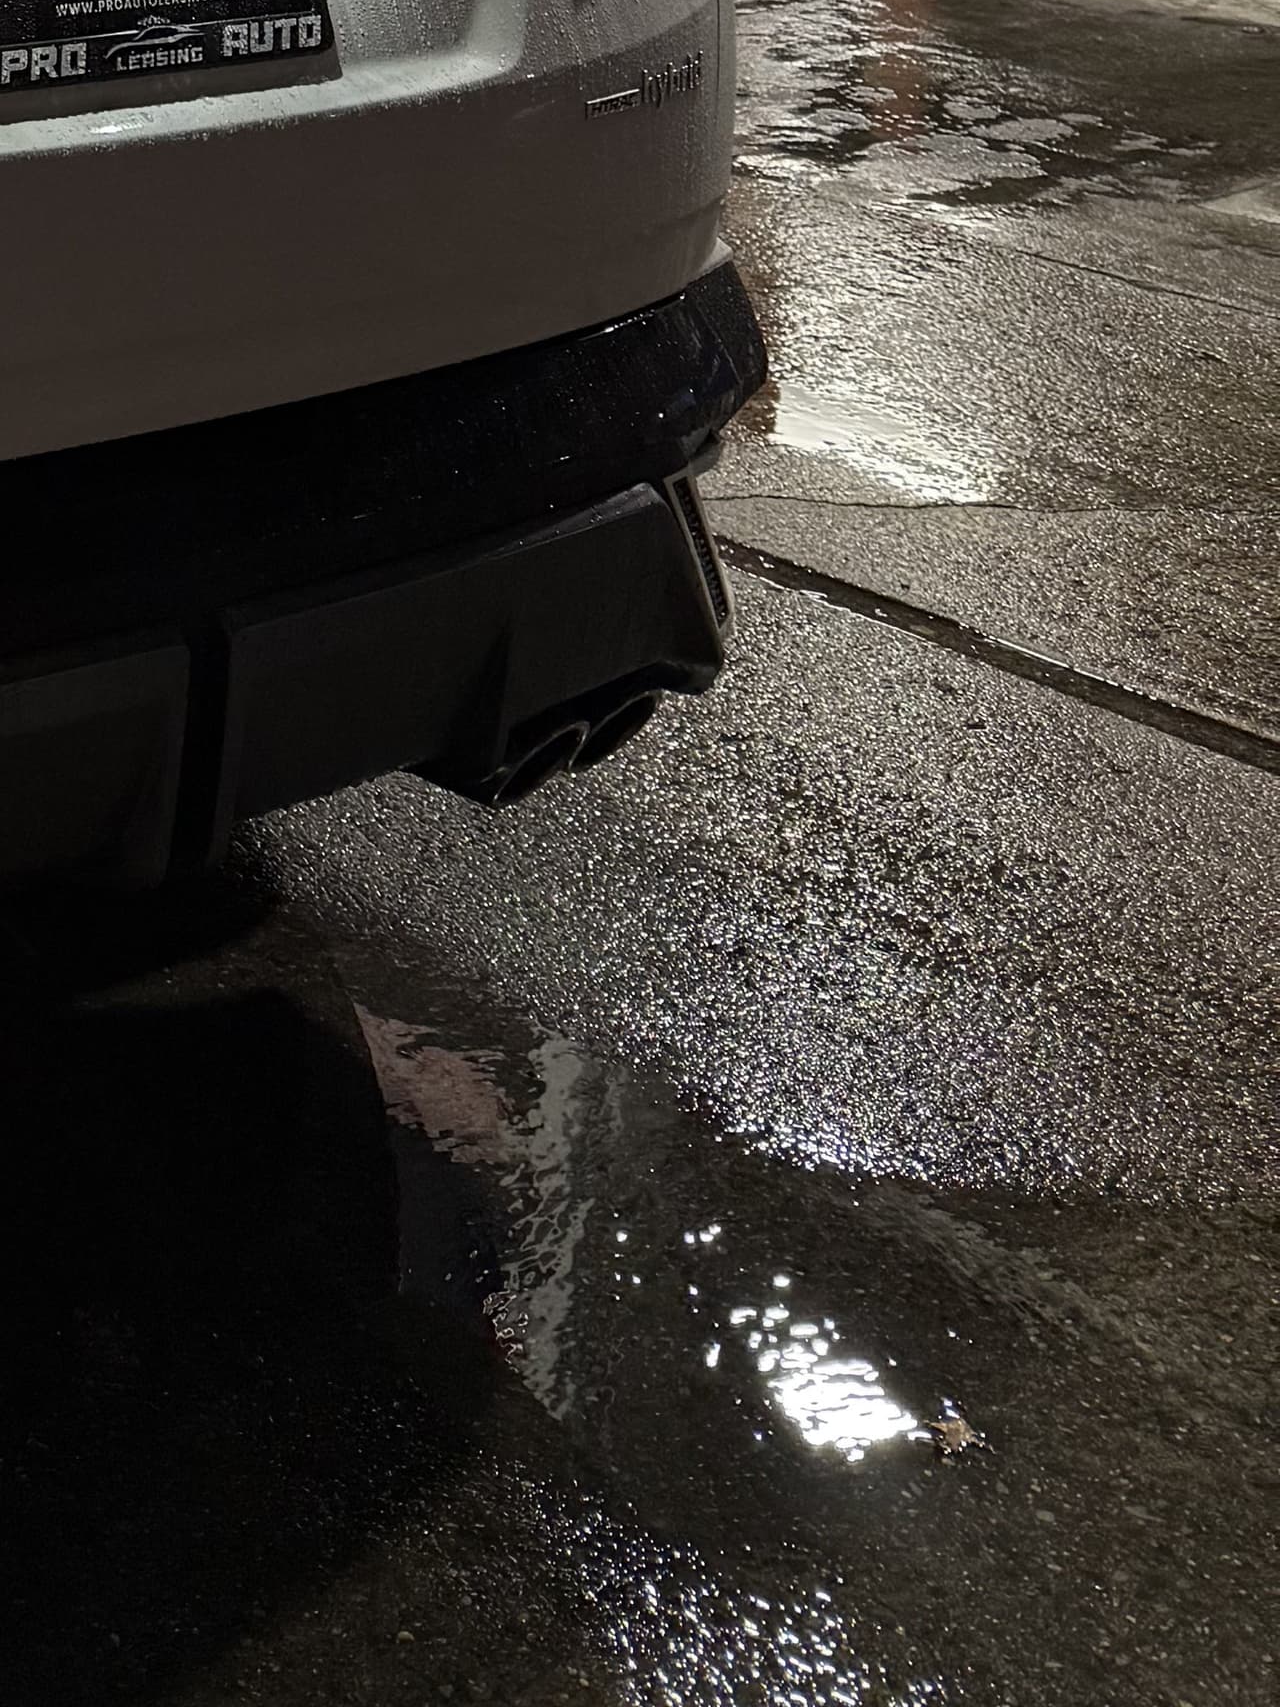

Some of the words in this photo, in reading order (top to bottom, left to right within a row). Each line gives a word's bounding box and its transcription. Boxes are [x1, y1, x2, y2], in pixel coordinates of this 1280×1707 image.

[0, 40, 88, 85] PRO
[115, 46, 204, 72] LEASING
[219, 15, 322, 58] AUTO
